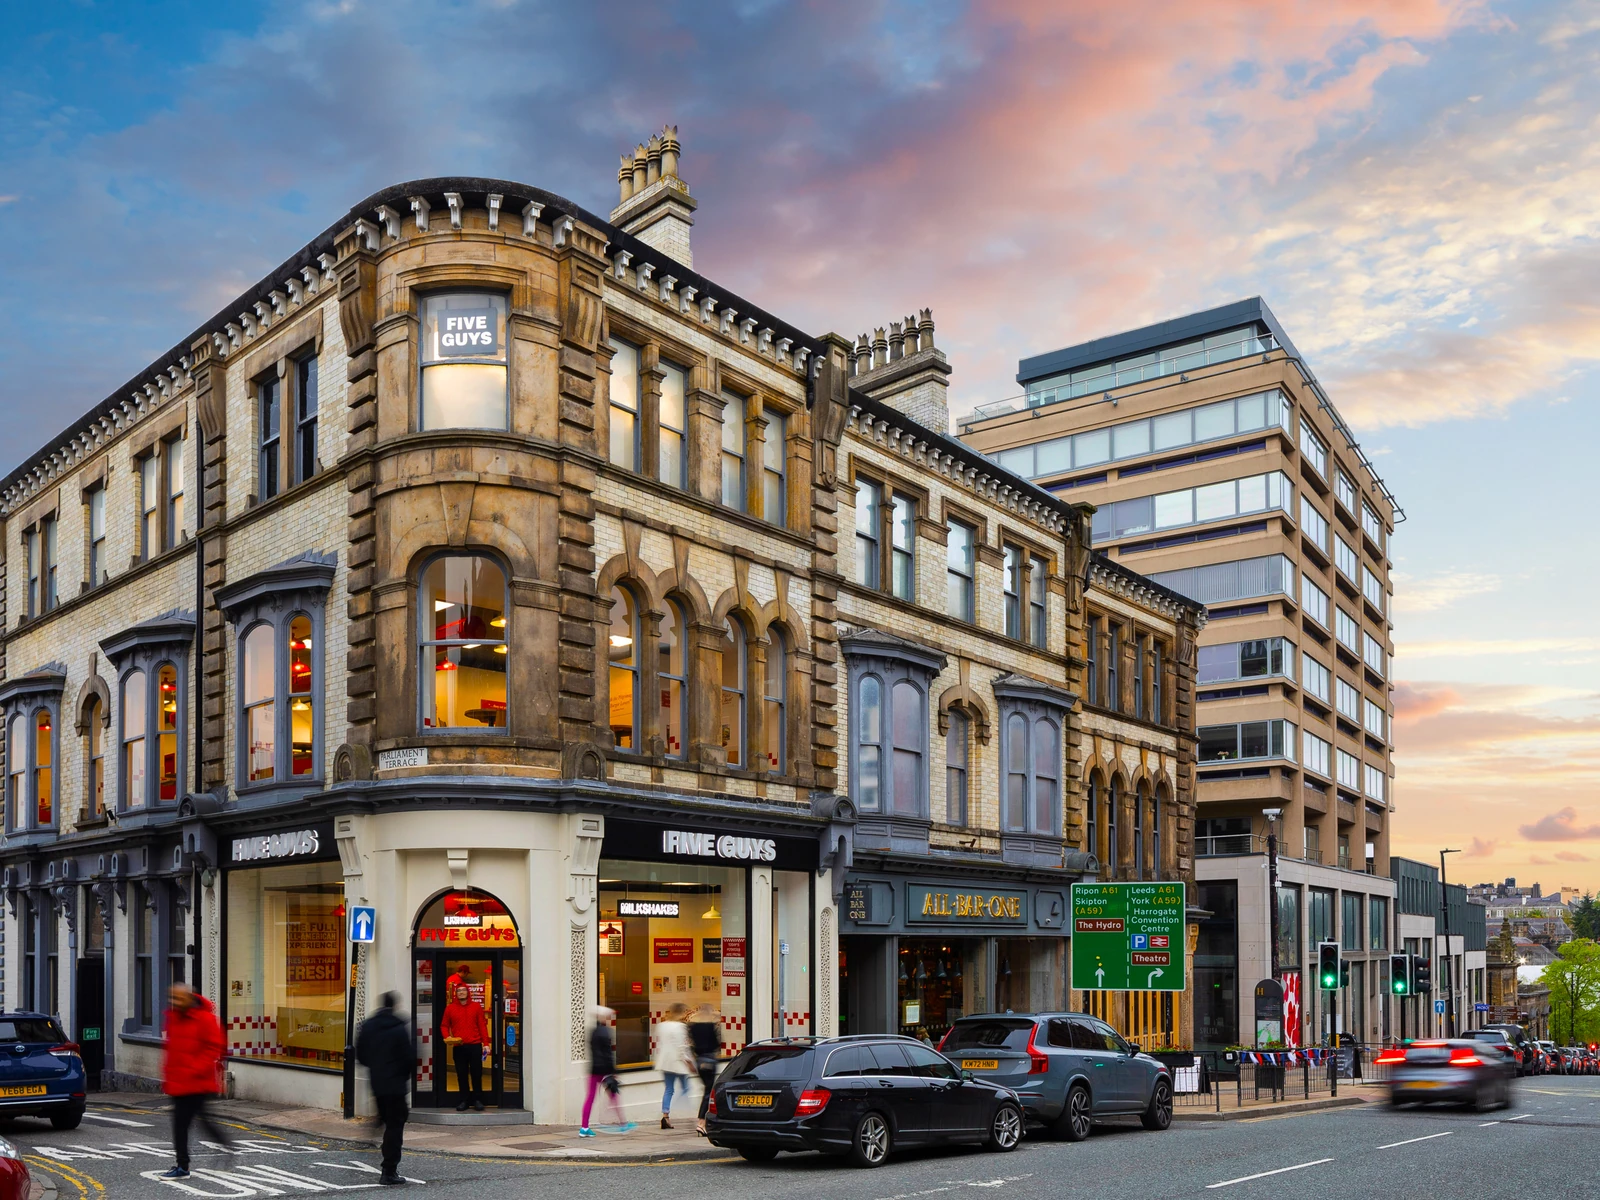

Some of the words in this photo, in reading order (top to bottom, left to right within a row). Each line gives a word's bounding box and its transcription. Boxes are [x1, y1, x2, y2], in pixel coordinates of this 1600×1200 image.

[446, 315, 487, 331] FIVE
[441, 331, 493, 347] GUYS
[380, 748, 425, 761] PARLIAMENT
[385, 757, 418, 769] TERRACE
[231, 836, 270, 861] FIVE
[269, 829, 319, 857] GUYS
[663, 830, 716, 857] FIVE
[717, 835, 777, 862] GUYS
[850, 890, 864, 899] ALL
[1075, 887, 1099, 896] Ripon
[1101, 886, 1118, 894] A61
[1131, 886, 1155, 894] Leeds
[850, 900, 865, 909] BAR
[1075, 897, 1108, 906] Skipton
[1131, 897, 1150, 905] York
[1152, 896, 1181, 905] (A59)
[620, 902, 679, 916] MILKSHAKES
[1075, 906, 1103, 916] (A59)
[1133, 908, 1177, 917] Harrogate
[849, 910, 866, 919] ONE
[1131, 916, 1179, 924] Convention
[310, 922, 337, 932] FULL
[1078, 921, 1093, 929] The
[1096, 921, 1121, 930] Hydro
[1140, 924, 1170, 933] Centre
[420, 928, 460, 941] FIVE
[464, 928, 515, 941] GUYS
[1134, 935, 1145, 948] P
[1134, 954, 1167, 963] Theatre
[288, 965, 335, 981] FRESH
